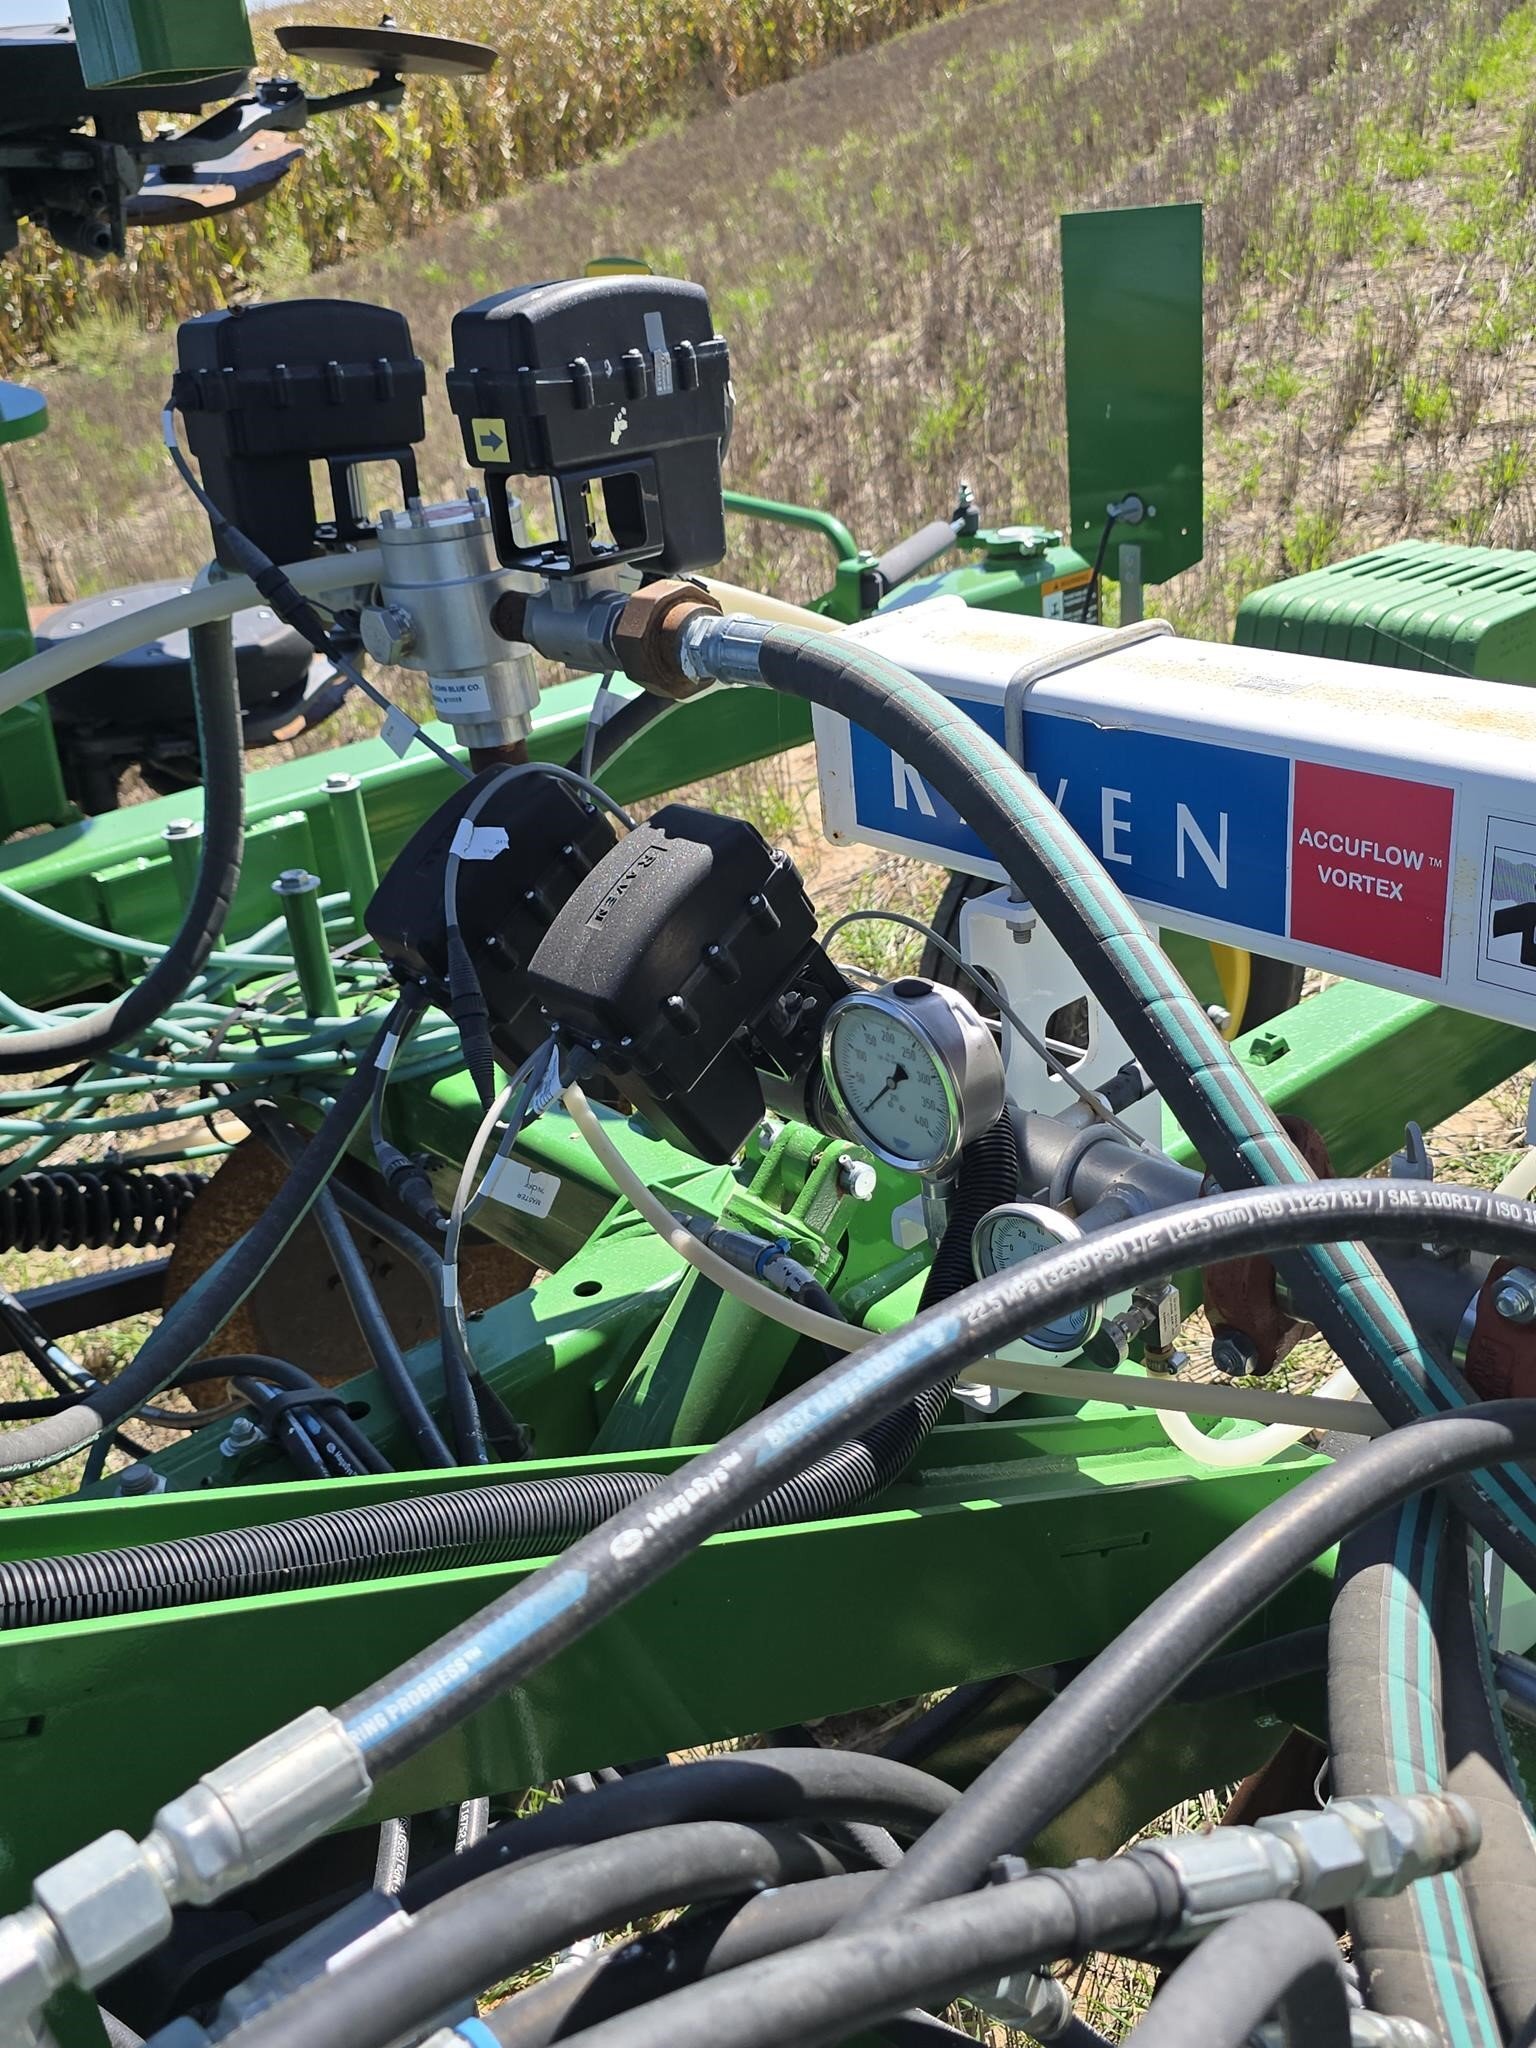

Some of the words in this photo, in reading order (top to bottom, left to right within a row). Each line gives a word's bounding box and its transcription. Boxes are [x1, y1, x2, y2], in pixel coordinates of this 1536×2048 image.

[467, 683, 481, 691] CO.
[891, 749, 1228, 889] REN
[1298, 828, 1424, 871] ACCUFLOW
[594, 852, 657, 922] RAVEN
[1317, 864, 1403, 902] VORTEX
[863, 1032, 877, 1046] 150
[881, 1030, 895, 1044] 200
[901, 1046, 916, 1061] 250
[917, 1072, 931, 1086] 300
[921, 1095, 936, 1110] 350
[914, 1114, 929, 1129] 400
[1017, 1228, 1026, 1239] 20
[965, 1295, 1003, 1325] 22.5
[1002, 1279, 1040, 1306] MPa
[1257, 1199, 1284, 1217] ISO
[1288, 1192, 1337, 1214] 11237
[1341, 1190, 1374, 1208] R17
[1388, 1189, 1418, 1206] SAE
[1423, 1190, 1481, 1212] 100R17
[1495, 1200, 1521, 1219] ISO
